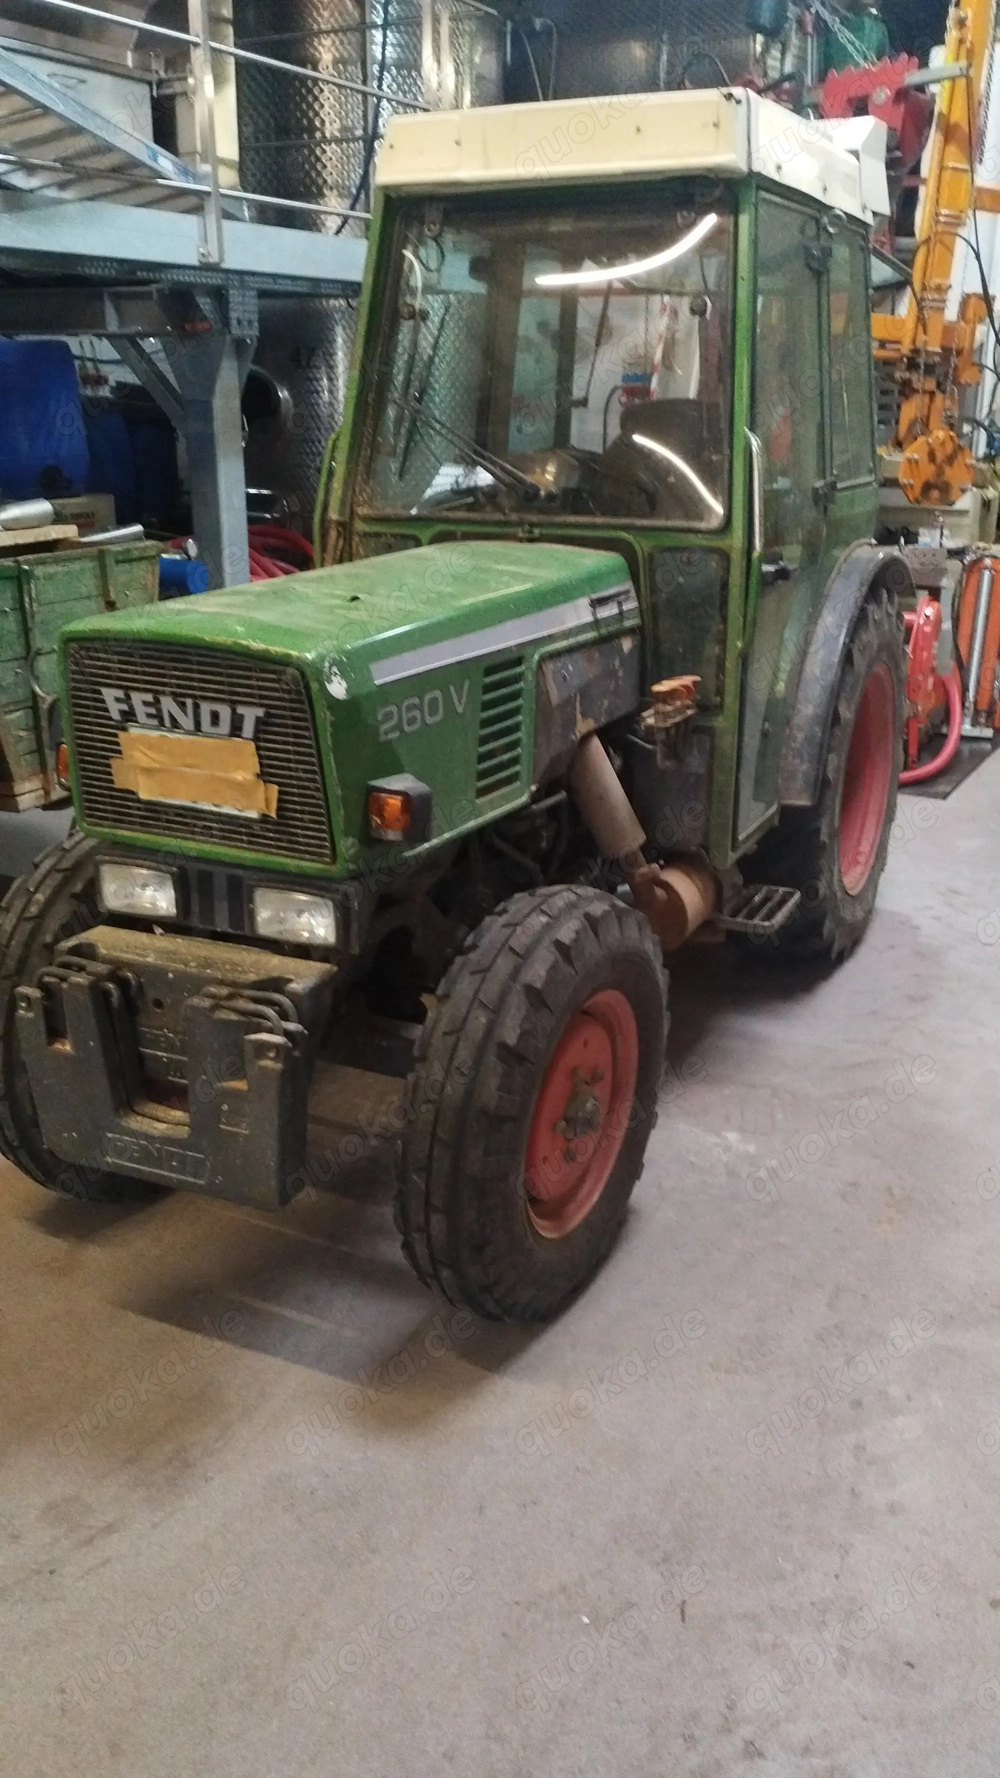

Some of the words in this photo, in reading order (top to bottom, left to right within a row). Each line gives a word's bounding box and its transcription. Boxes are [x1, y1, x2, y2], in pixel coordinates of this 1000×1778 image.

[101, 687, 267, 739] FENDT
[378, 689, 443, 741] 260
[448, 678, 470, 714] V
